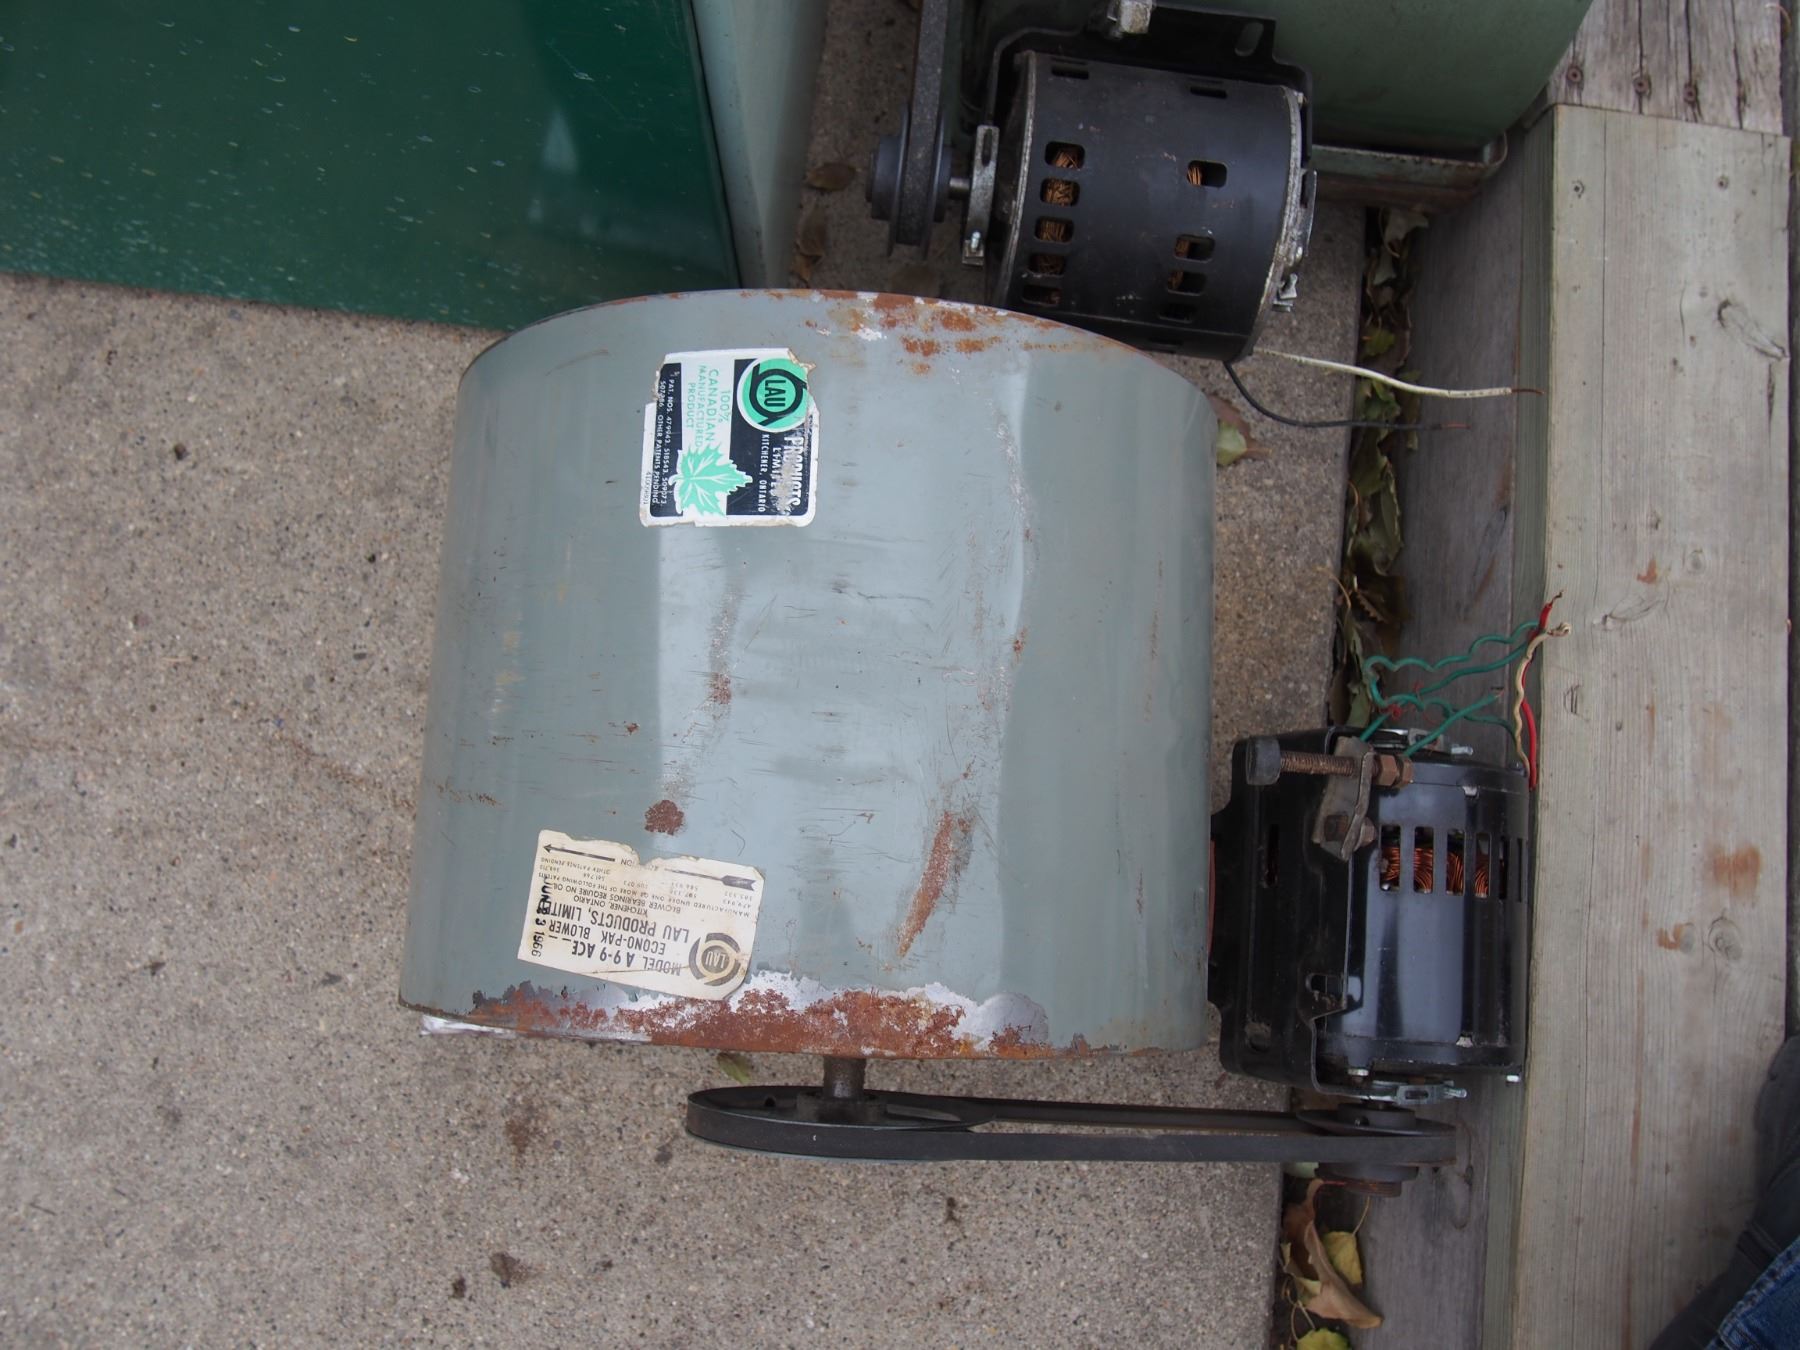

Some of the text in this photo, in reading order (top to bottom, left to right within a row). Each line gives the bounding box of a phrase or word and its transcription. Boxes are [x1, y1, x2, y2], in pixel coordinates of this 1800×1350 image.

[764, 380, 786, 406] LAU
[686, 382, 696, 428] PRODUCT
[695, 365, 706, 447] MANUFACTURED
[705, 369, 719, 441] CANADIAN
[719, 390, 730, 422] 100%
[758, 480, 767, 512] ONTARIO
[562, 876, 596, 887] FOLLOWING
[565, 885, 576, 893] NO
[578, 887, 607, 899] REQUIRE
[609, 893, 645, 906] BEARINGS
[619, 887, 635, 895] MORE
[572, 894, 605, 907] ONTARIO
[648, 900, 680, 913] BLOWER
[668, 897, 690, 906] UNDER
[693, 902, 749, 917] MANUFACTURED
[587, 907, 656, 936] PRODUCTS,
[549, 919, 665, 955] ECONO-PAK BLOWER
[663, 924, 689, 942] LAU
[644, 956, 681, 976] MODEL
[705, 950, 726, 969] LAU
